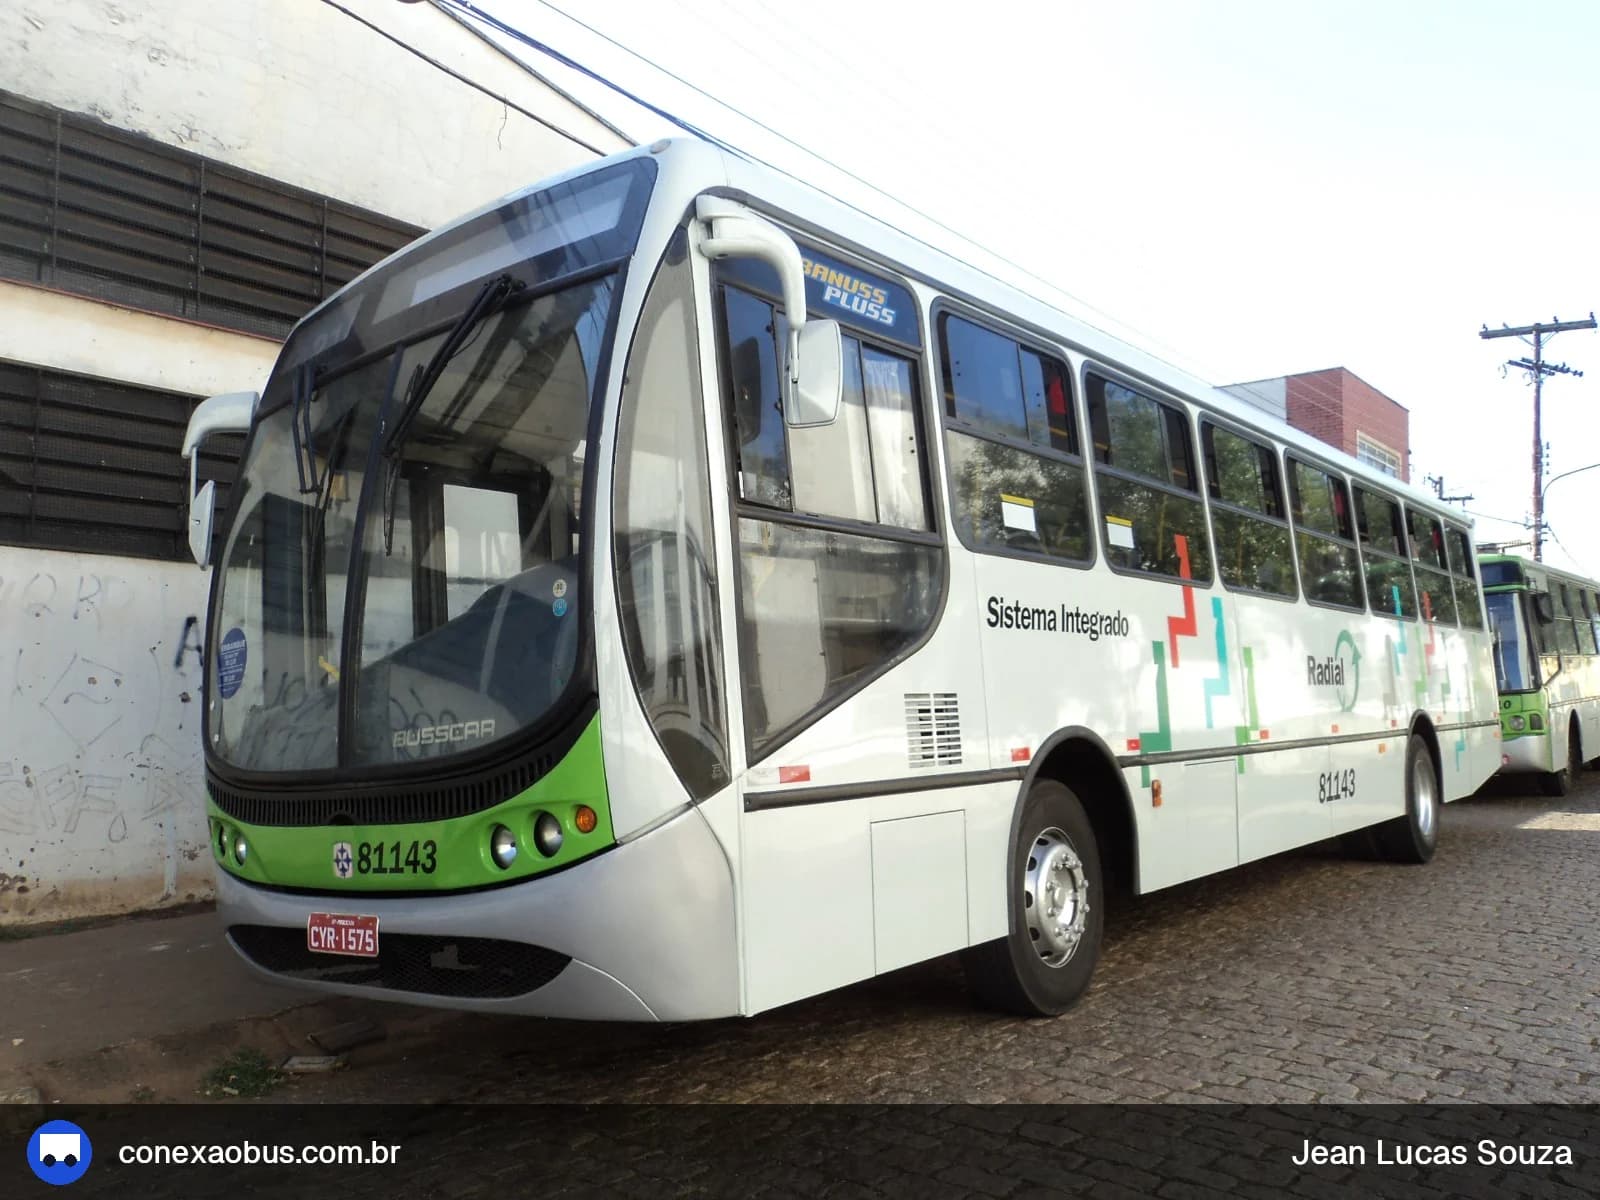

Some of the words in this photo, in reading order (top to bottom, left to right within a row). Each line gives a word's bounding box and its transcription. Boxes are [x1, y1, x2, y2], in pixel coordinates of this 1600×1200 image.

[823, 286, 896, 325] PLUSS
[987, 596, 1057, 631] Sistema
[1061, 604, 1129, 641] Integrado
[1307, 655, 1345, 686] Radial
[392, 719, 496, 749] BUSSCAR
[1319, 768, 1355, 804] 81143
[357, 840, 437, 874] 81143
